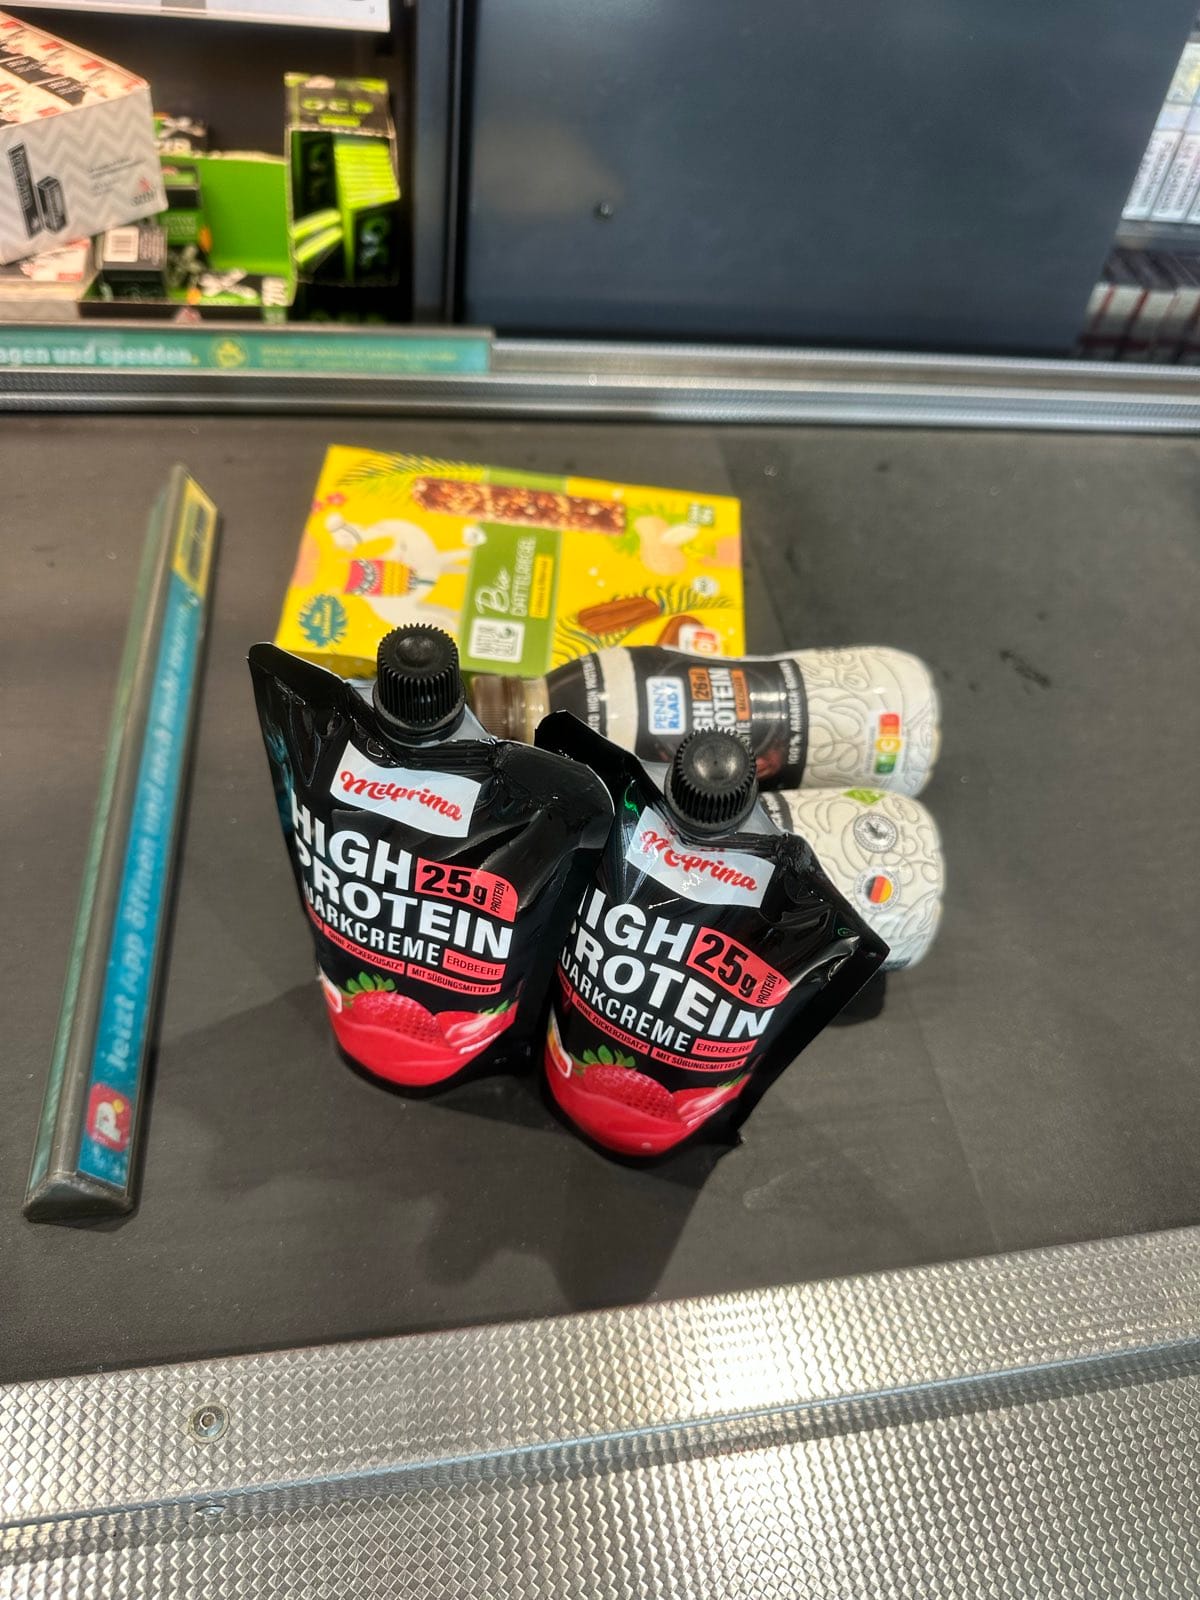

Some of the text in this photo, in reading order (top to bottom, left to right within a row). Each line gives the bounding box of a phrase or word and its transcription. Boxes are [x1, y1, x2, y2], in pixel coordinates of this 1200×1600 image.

[51, 339, 95, 365] und
[474, 565, 512, 615] Bio
[583, 662, 598, 689] PROTEIN
[586, 691, 601, 713] HIGH
[651, 684, 666, 730] PENNY
[692, 701, 714, 733] GH
[708, 667, 736, 735] OTEIN
[787, 746, 801, 765] 100
[340, 770, 463, 823] Milprima
[291, 787, 488, 906] HIGH 25g
[126, 837, 157, 929] öffnen
[489, 880, 506, 914] PROTEIN
[303, 876, 501, 977] UARKCREME ERDBEERE
[578, 883, 758, 998] IGH 25g
[119, 933, 148, 996] App
[328, 930, 345, 947] OHNE
[411, 967, 426, 979] MIT
[560, 945, 692, 1053] UARKCREME
[571, 920, 776, 1039] ROTEIN
[755, 971, 778, 1005] PROTEIN
[655, 1050, 671, 1062] MIT
